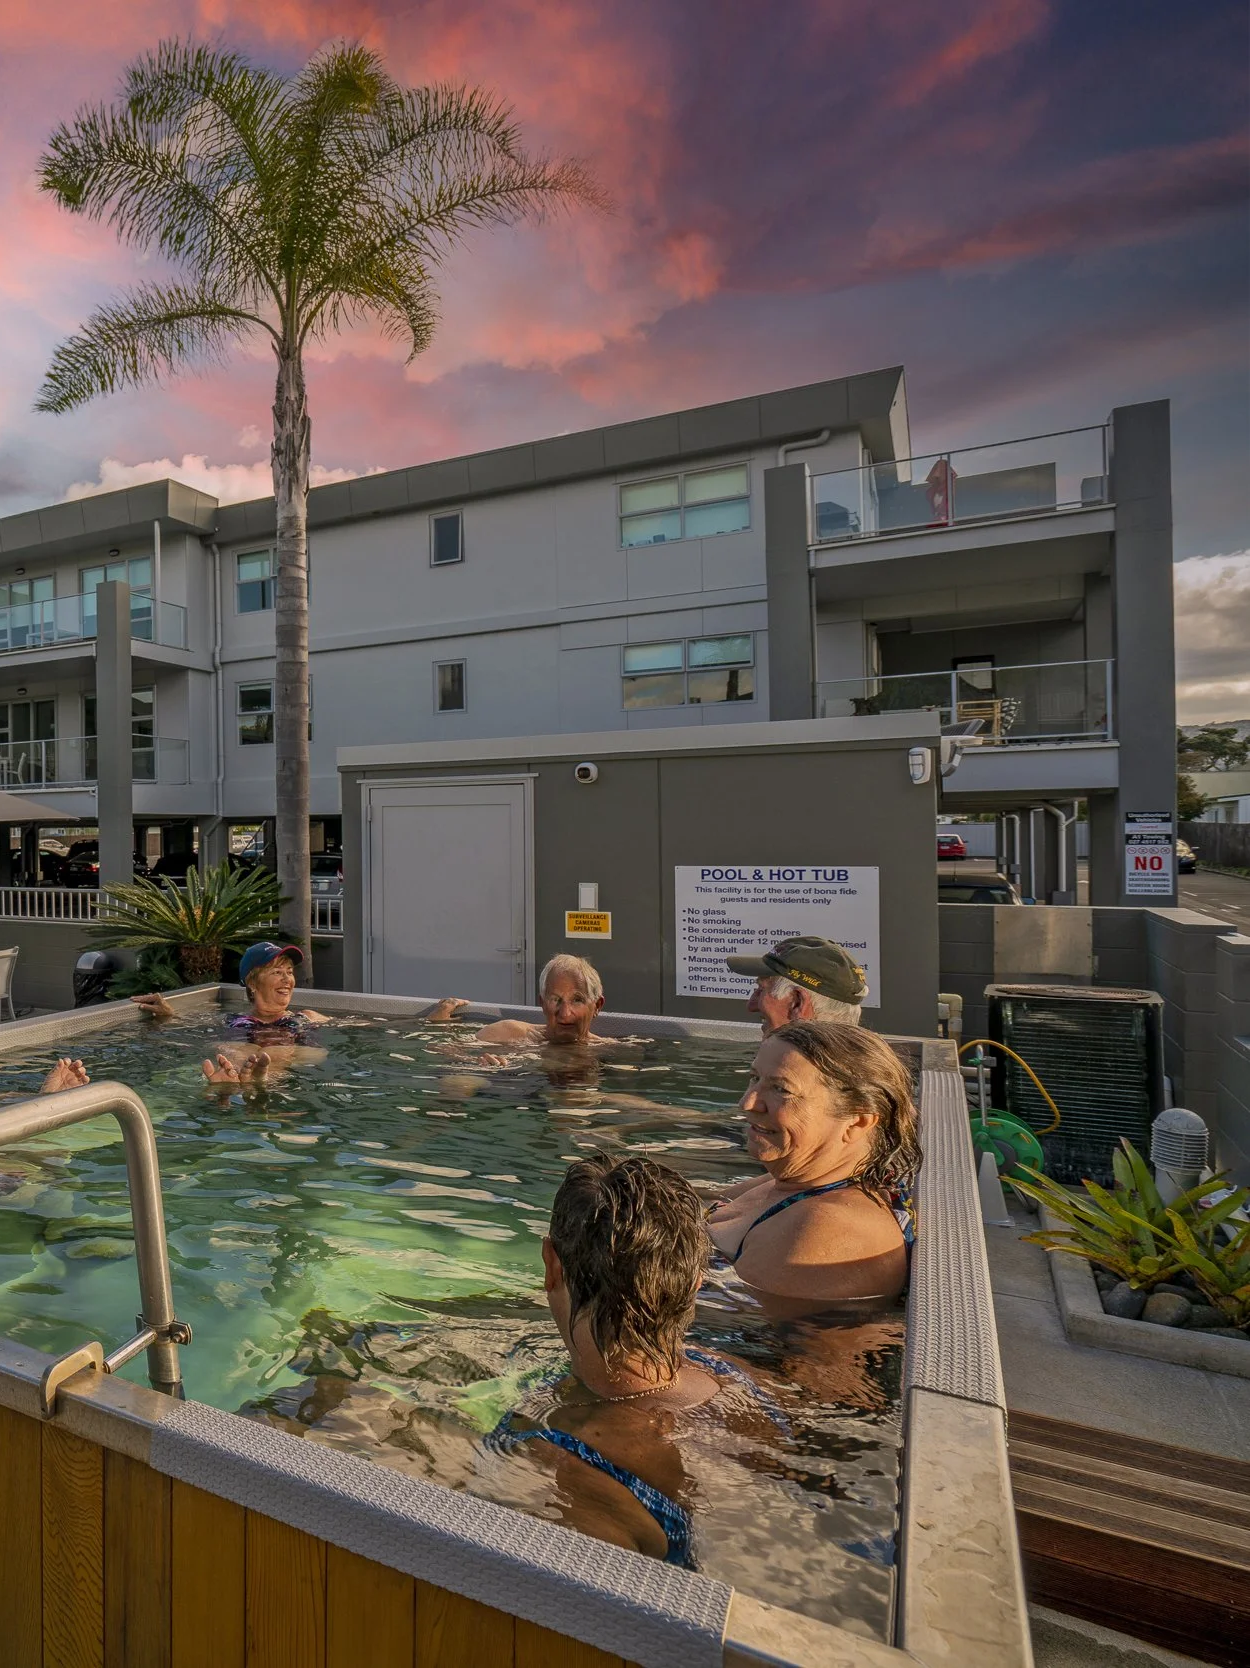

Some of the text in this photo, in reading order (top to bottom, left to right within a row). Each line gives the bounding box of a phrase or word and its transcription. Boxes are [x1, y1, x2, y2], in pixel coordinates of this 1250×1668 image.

[1134, 856, 1163, 870] NO
[701, 868, 849, 881] POOL & HOT TUB
[714, 886, 742, 895] facility
[720, 896, 749, 904] guests
[769, 896, 810, 904] residents
[812, 897, 831, 905] only
[687, 907, 726, 916] No glass
[702, 918, 742, 926] smoking
[702, 927, 756, 935] considerate
[758, 928, 768, 936] of
[770, 929, 801, 937] others
[687, 935, 725, 943] Children
[727, 937, 754, 945] under
[688, 945, 698, 953] by
[714, 945, 738, 954] adult
[688, 965, 724, 974] persons
[688, 974, 717, 982] others
[788, 968, 822, 987] Fly Wild
[689, 984, 698, 992] In
[700, 985, 751, 996] Emergency
